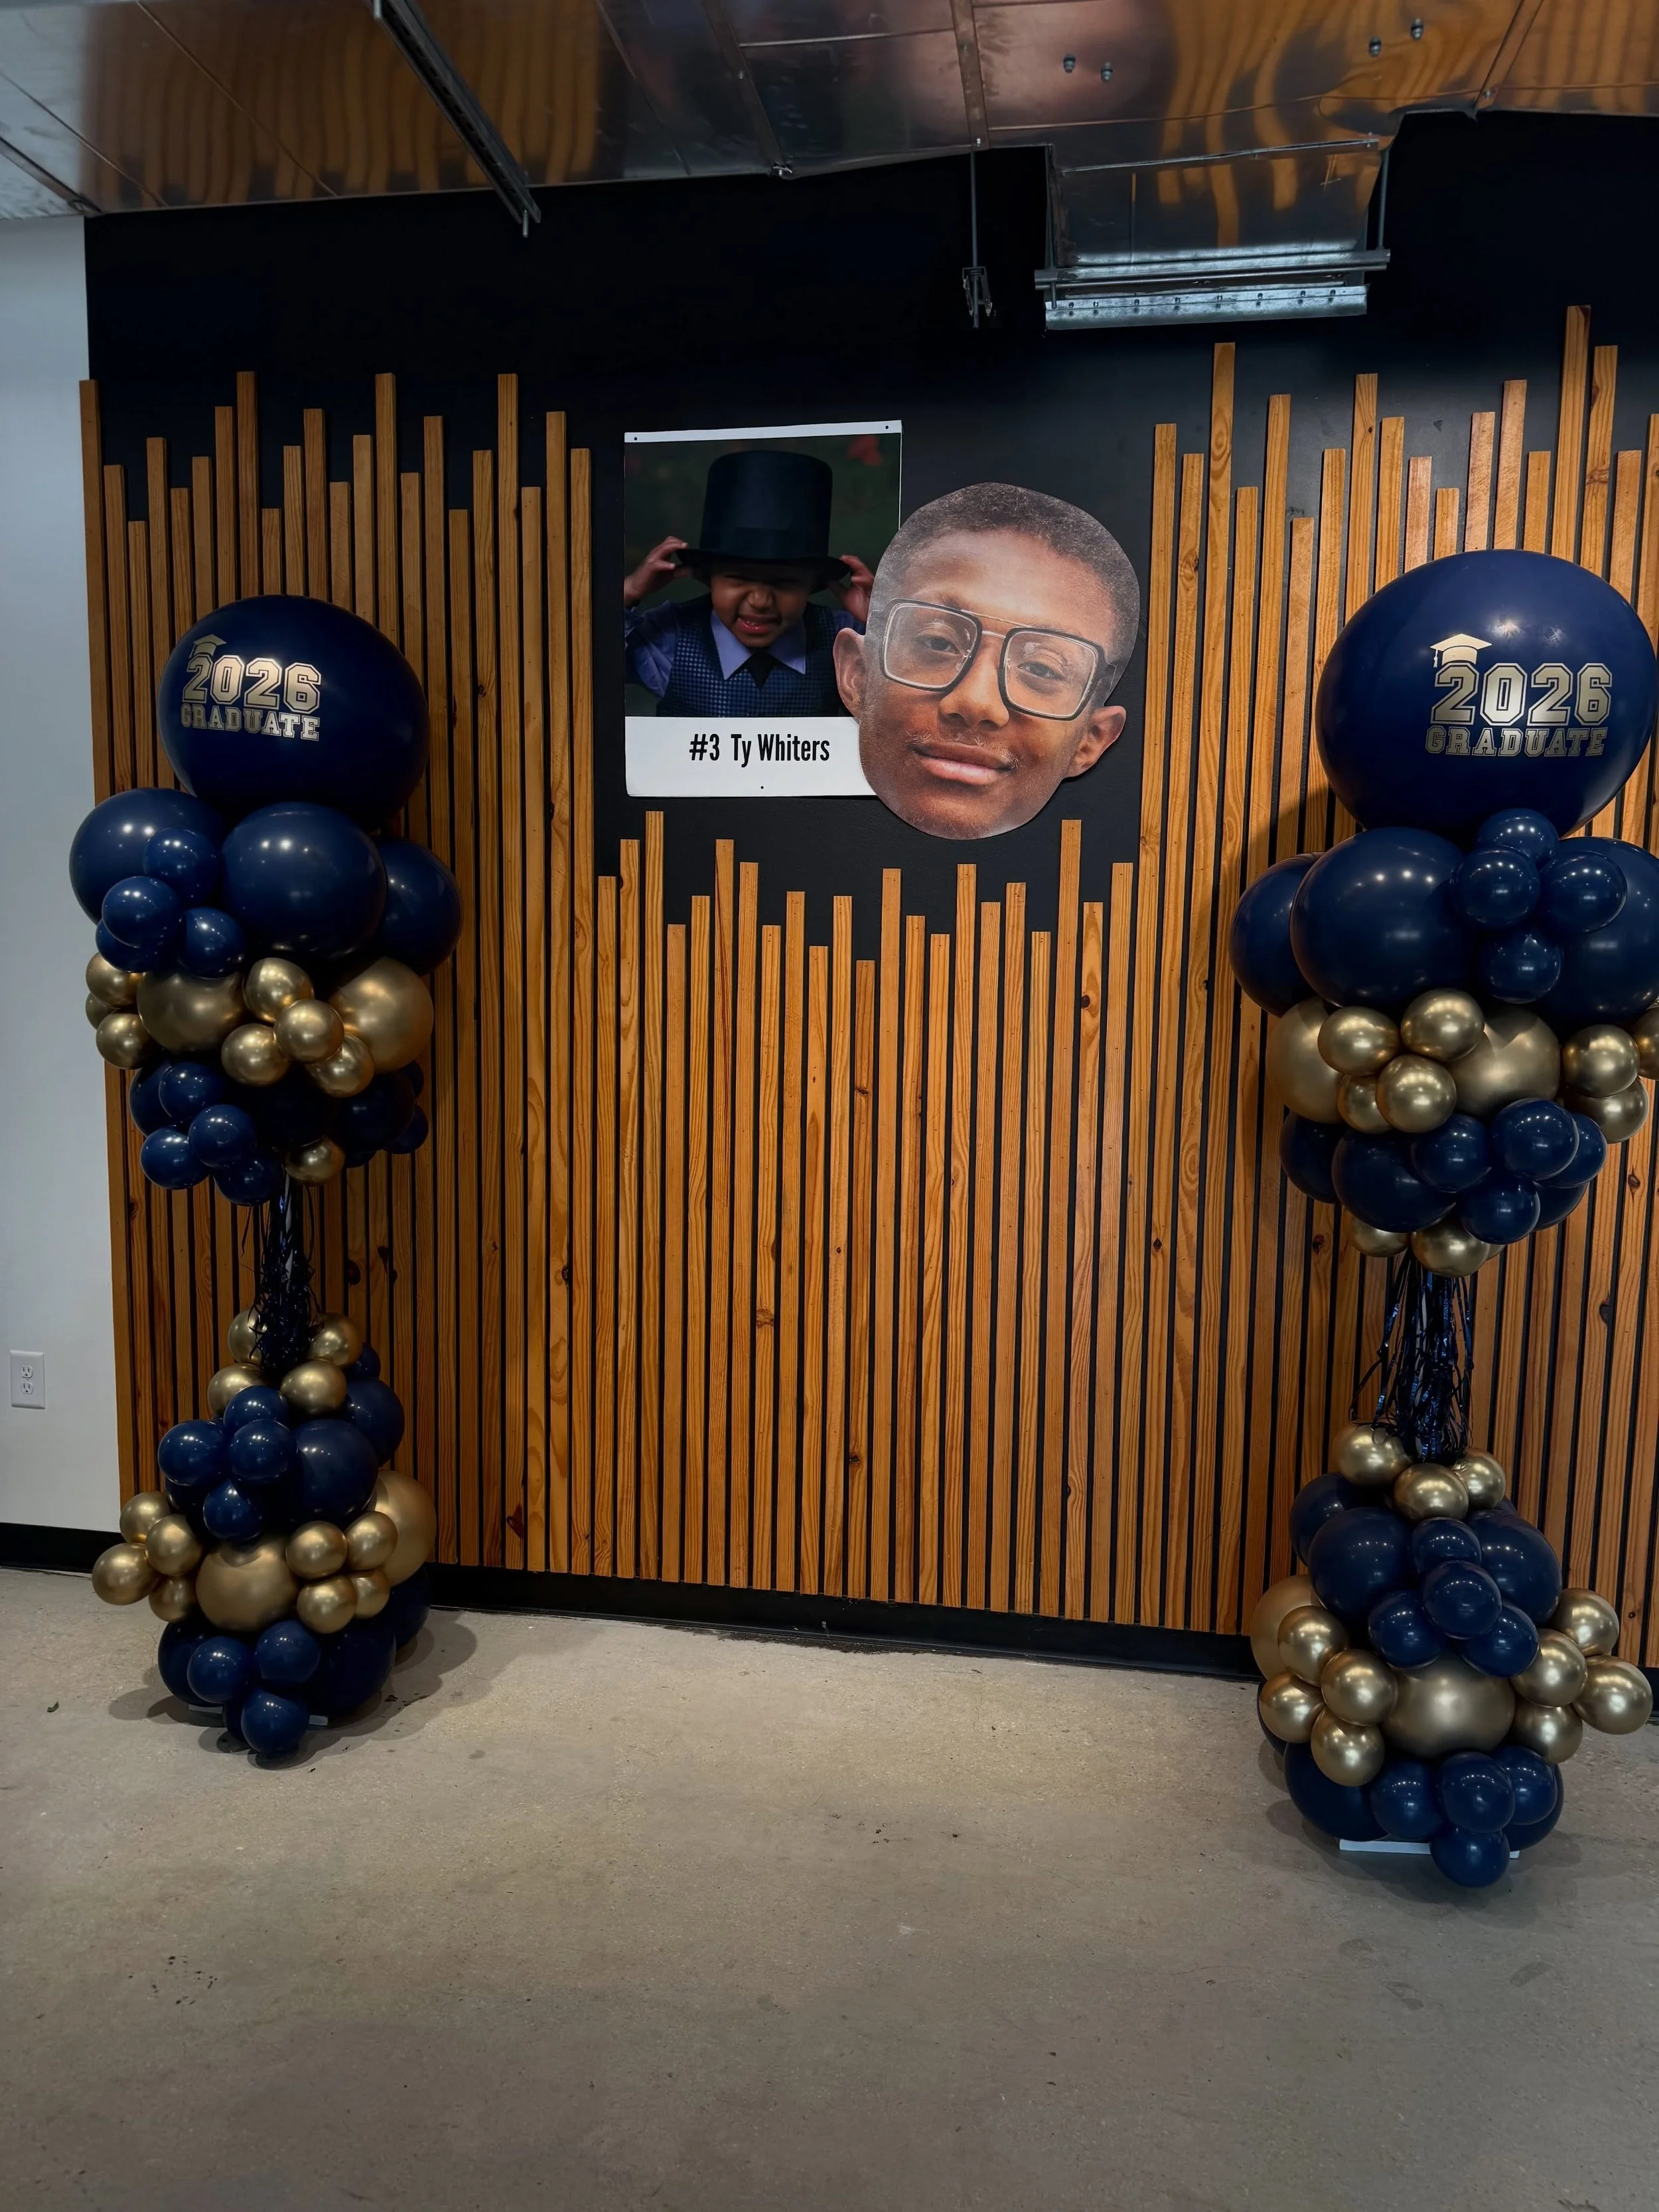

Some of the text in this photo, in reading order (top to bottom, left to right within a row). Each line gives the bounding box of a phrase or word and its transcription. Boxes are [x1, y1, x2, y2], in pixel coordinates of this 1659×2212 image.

[182, 654, 322, 714] 2026
[1430, 662, 1613, 726] 2026
[180, 703, 321, 741] GRADUATE
[1425, 725, 1609, 757] GRADUATE
[689, 733, 830, 768] #3 Ty Whiters
